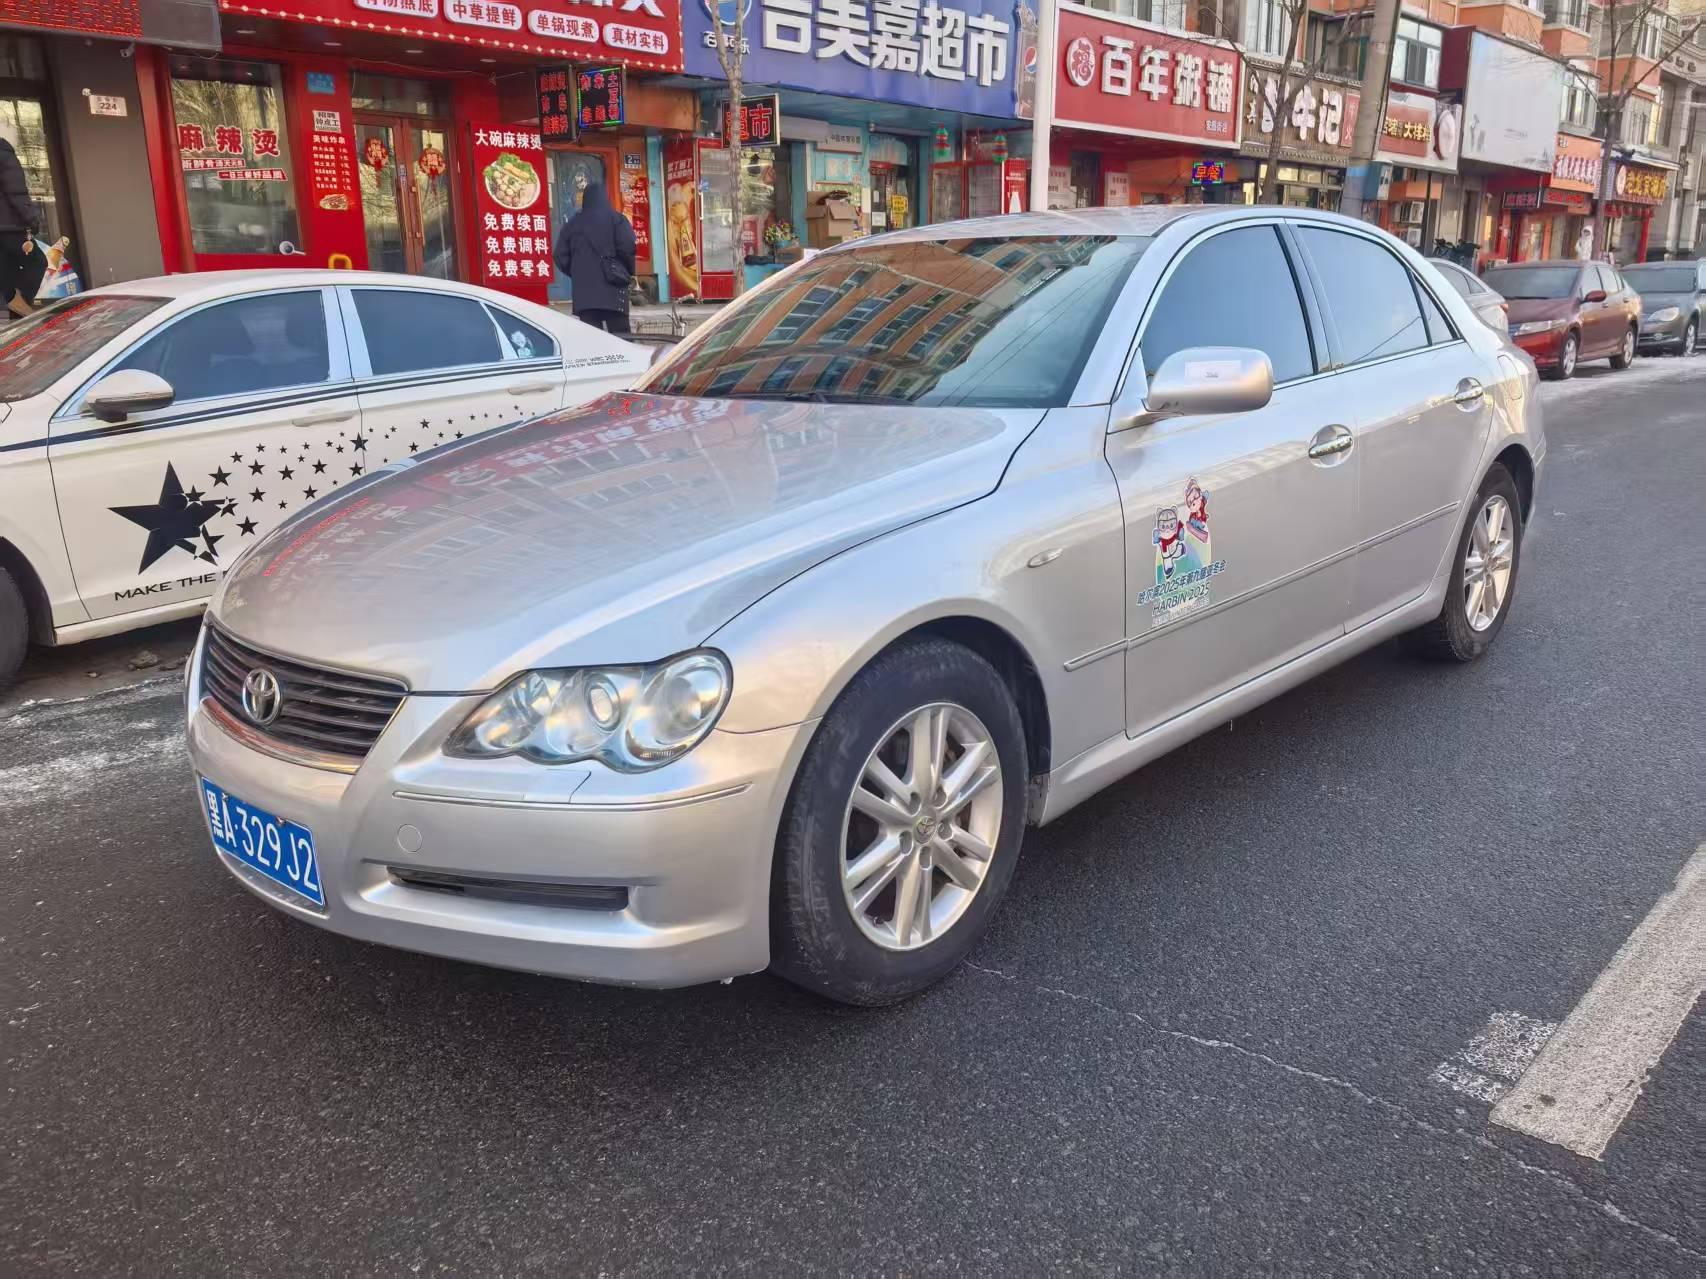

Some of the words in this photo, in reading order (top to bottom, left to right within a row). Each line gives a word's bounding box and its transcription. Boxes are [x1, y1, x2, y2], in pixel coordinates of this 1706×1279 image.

[453, 3, 516, 26] 中草提鲜
[537, 13, 594, 39] 单锅现煮
[611, 27, 664, 51] 真材实料
[703, 31, 750, 55] 百可乐
[763, 0, 1009, 87] 吉美嘉超市
[1101, 35, 1233, 113] 百年粥铺
[177, 123, 281, 157] 麻辣烫
[475, 128, 543, 150] 大碗麻辣烫
[1195, 165, 1221, 181] 早餐
[484, 213, 547, 232] 免费续面
[486, 236, 549, 255] 免费调料
[487, 259, 551, 278] 免费零食
[114, 581, 172, 601] MAKE
[176, 572, 216, 588] THE
[1153, 592, 1187, 611] HARBIN
[1188, 582, 1210, 601] 2025
